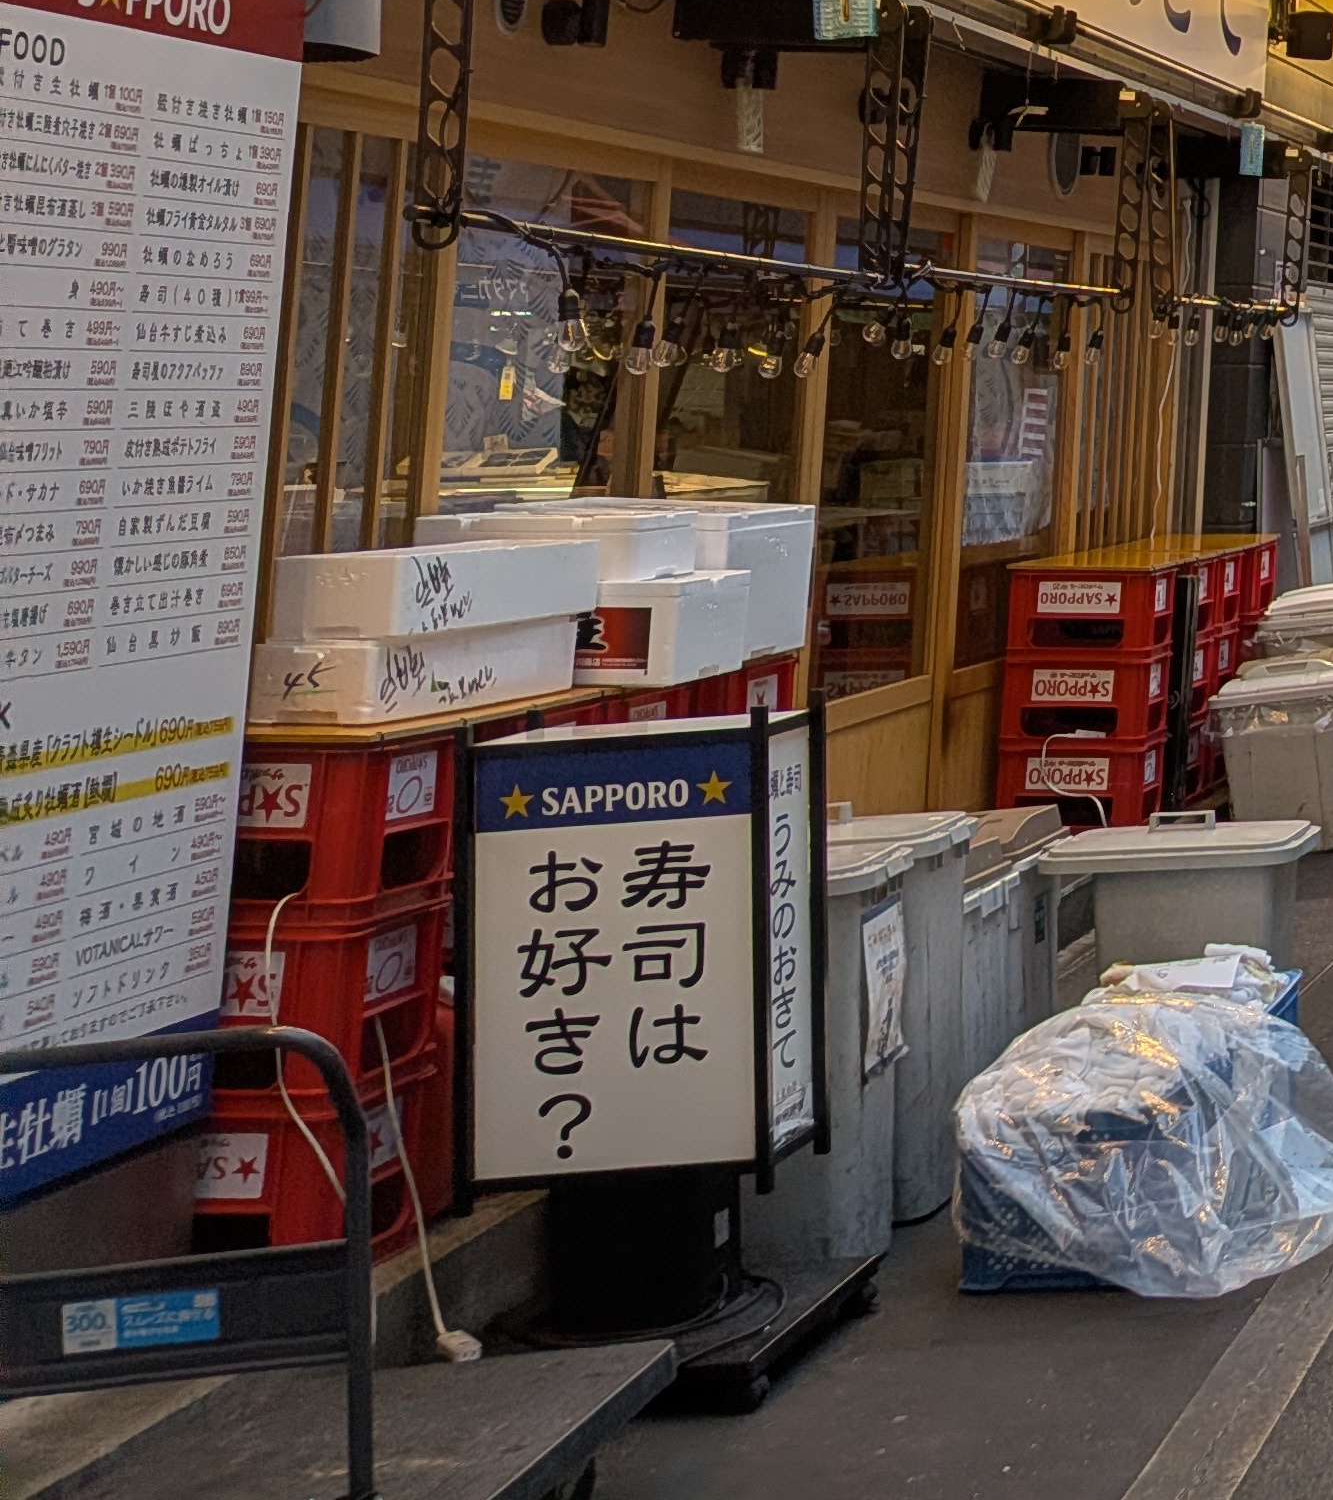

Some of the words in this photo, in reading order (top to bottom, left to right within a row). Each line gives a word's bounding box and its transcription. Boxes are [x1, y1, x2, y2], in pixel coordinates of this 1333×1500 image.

[0, 27, 66, 66] FOOD
[119, 86, 143, 104] 100円
[113, 122, 139, 142] 690円
[109, 163, 136, 182] 390円
[256, 182, 279, 199] 690円
[254, 215, 277, 233] 690円
[101, 241, 128, 258] 990円
[90, 360, 117, 376] 590円
[86, 399, 113, 416] 590円
[83, 440, 110, 457] 790円
[78, 479, 107, 496] 690円
[75, 518, 102, 536] 790円
[70, 558, 98, 576] 990円
[66, 598, 95, 616] 690円
[1040, 591, 1103, 606] SAPPORO
[540, 779, 690, 817] SAPPORO
[769, 812, 797, 1070] うみのおきて
[622, 840, 713, 1067] 寿司は
[517, 850, 611, 1160] お好き?
